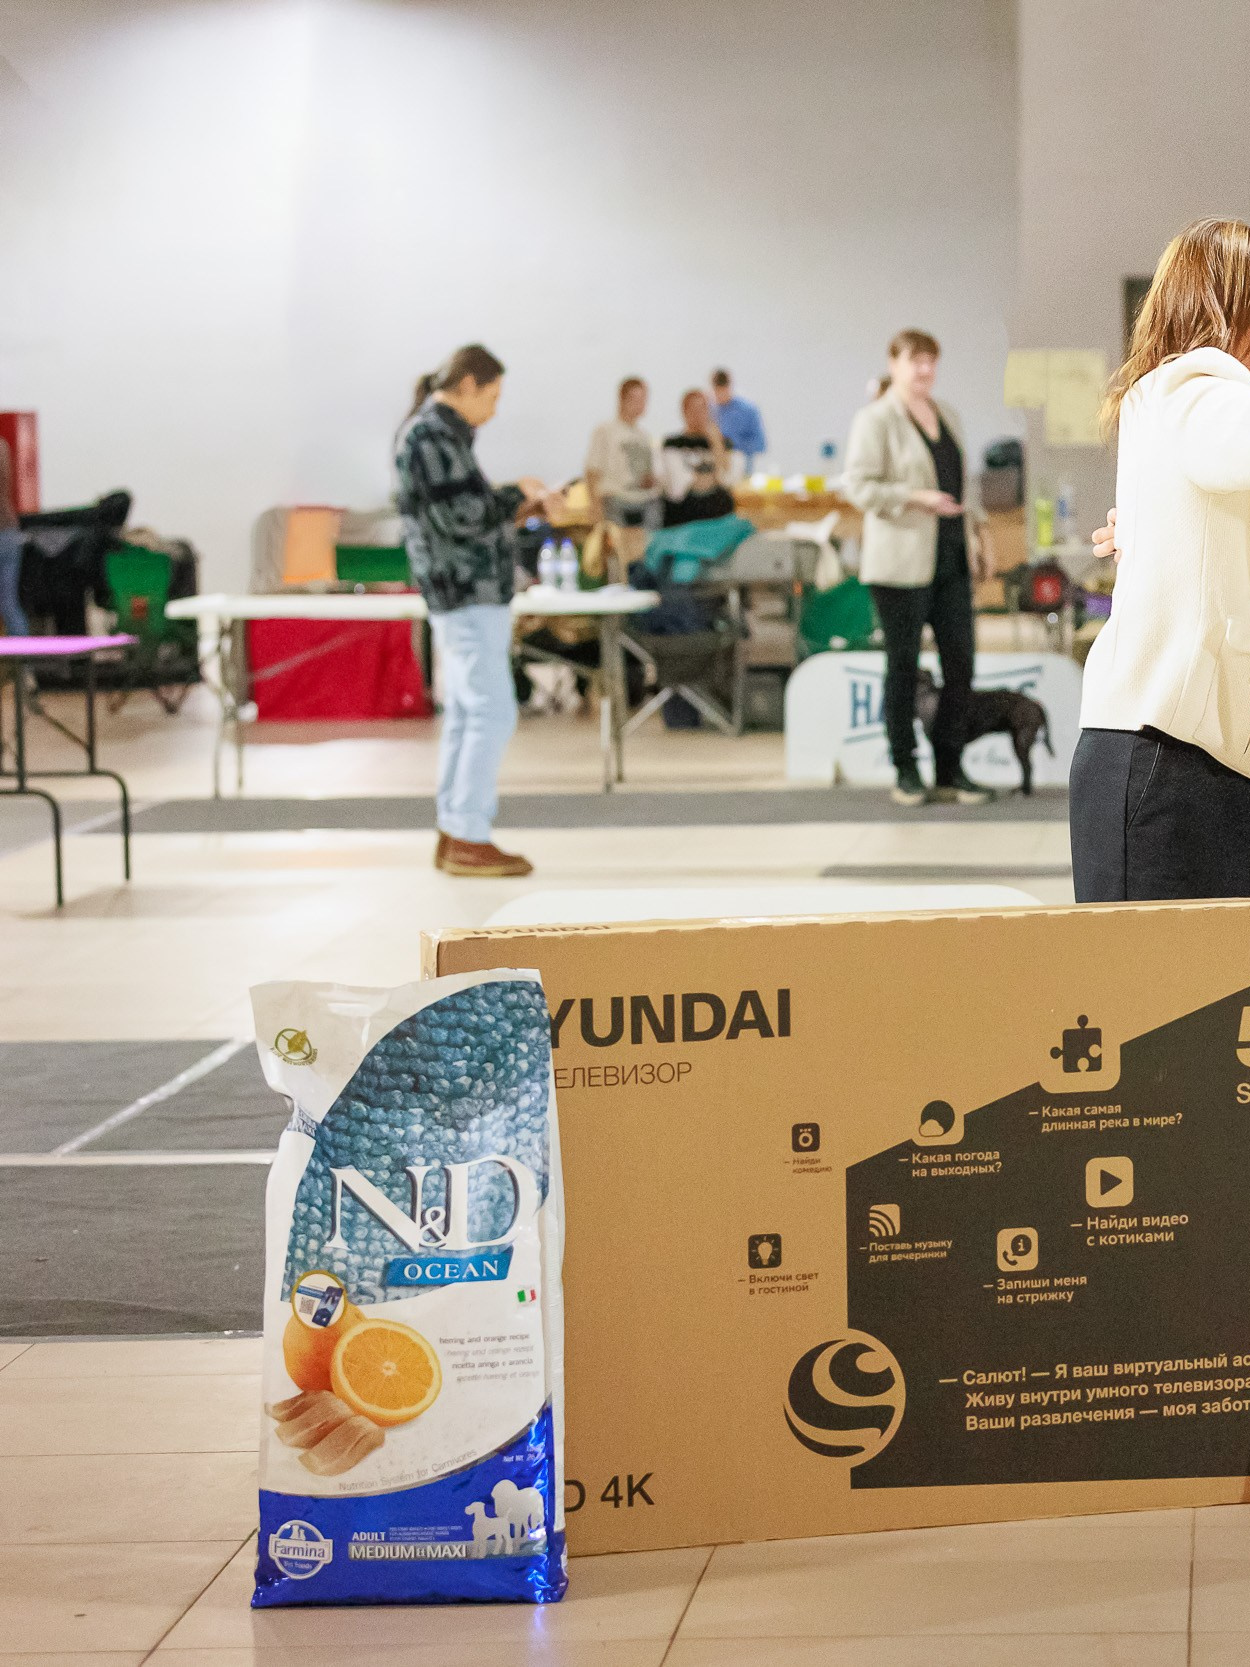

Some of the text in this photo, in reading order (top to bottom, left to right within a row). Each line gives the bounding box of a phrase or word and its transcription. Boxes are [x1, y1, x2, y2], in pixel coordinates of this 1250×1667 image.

[550, 988, 791, 1049] YUNDAI
[554, 1061, 692, 1089] ЕЛЕВИЗОР
[1041, 1106, 1081, 1118] Какая
[1084, 1104, 1122, 1116] самая
[1041, 1112, 1183, 1133] длинная река в мире?
[912, 1152, 952, 1164] Какая
[955, 1150, 1000, 1164] погода
[912, 1161, 1002, 1178] на выходных?
[326, 1153, 540, 1253] N&D
[1086, 1215, 1138, 1232] Найди
[1142, 1214, 1189, 1227] видео
[869, 1242, 912, 1253] Поставь
[915, 1239, 952, 1252] музыку
[1086, 1231, 1174, 1246] с котиками
[869, 1250, 947, 1264] для вечеринки
[403, 1259, 500, 1280] OCEAN
[749, 1273, 793, 1285] Включи
[795, 1272, 819, 1282] свет
[758, 1282, 809, 1296] гостиной
[997, 1277, 1050, 1291] Запиши
[1053, 1275, 1087, 1287] меня
[997, 1290, 1074, 1305] на стрижку
[963, 1367, 1026, 1387] Салют!
[1055, 1363, 1068, 1378] Я
[1072, 1364, 1108, 1378] ваш
[1113, 1353, 1228, 1377] виртуальный
[965, 1392, 1015, 1409] Живу
[1020, 1387, 1081, 1406] внутри
[1086, 1384, 1149, 1402] умного
[965, 1414, 1015, 1431] Ваши
[1019, 1407, 1135, 1429] развлечения
[1163, 1402, 1197, 1417] моя
[431, 1449, 478, 1472] Carnivores
[600, 1472, 655, 1509] 4K
[352, 1531, 386, 1541] ADULT
[274, 1540, 325, 1558] Farmina
